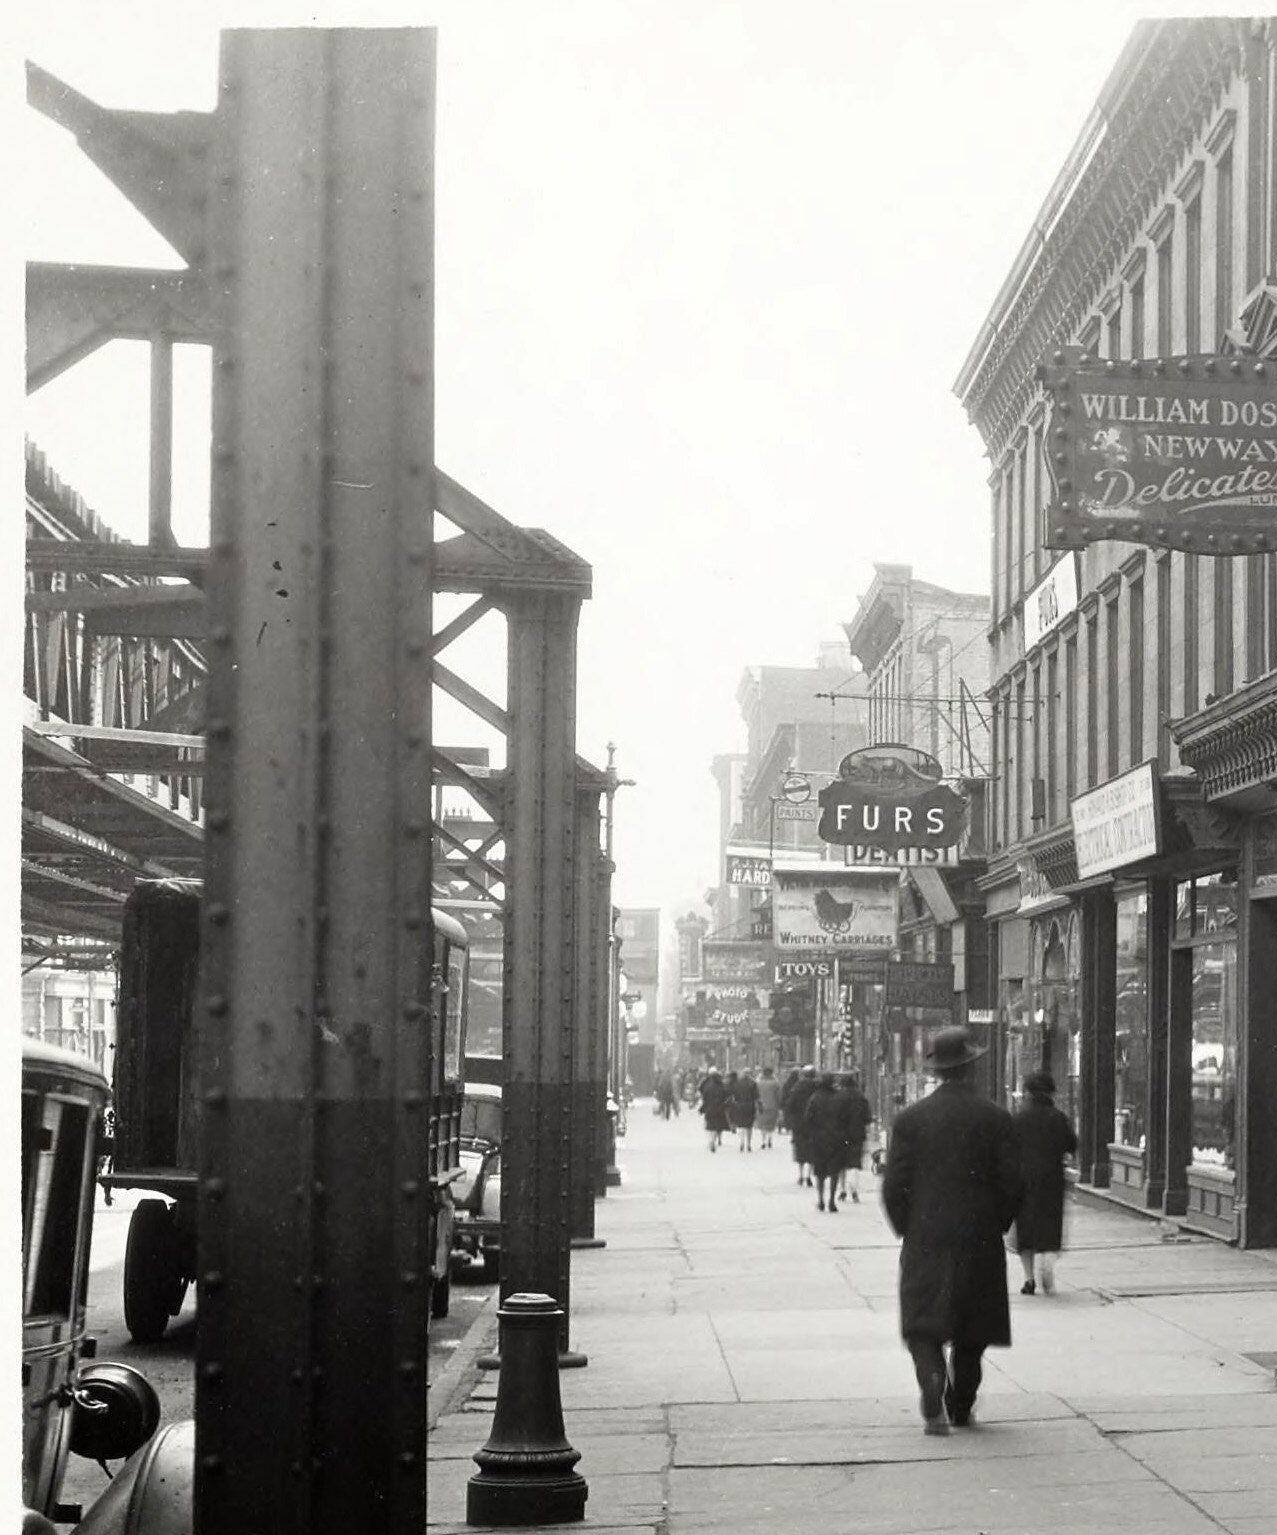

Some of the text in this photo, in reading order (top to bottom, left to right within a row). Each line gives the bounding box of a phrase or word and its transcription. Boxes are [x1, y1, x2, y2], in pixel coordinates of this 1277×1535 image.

[1081, 393, 1210, 424] WILLIAM
[837, 805, 944, 834] FURS
[850, 843, 949, 863] DETIST
[780, 933, 893, 945] WHITNEY CARRIAGES
[783, 963, 830, 976] TOYS
